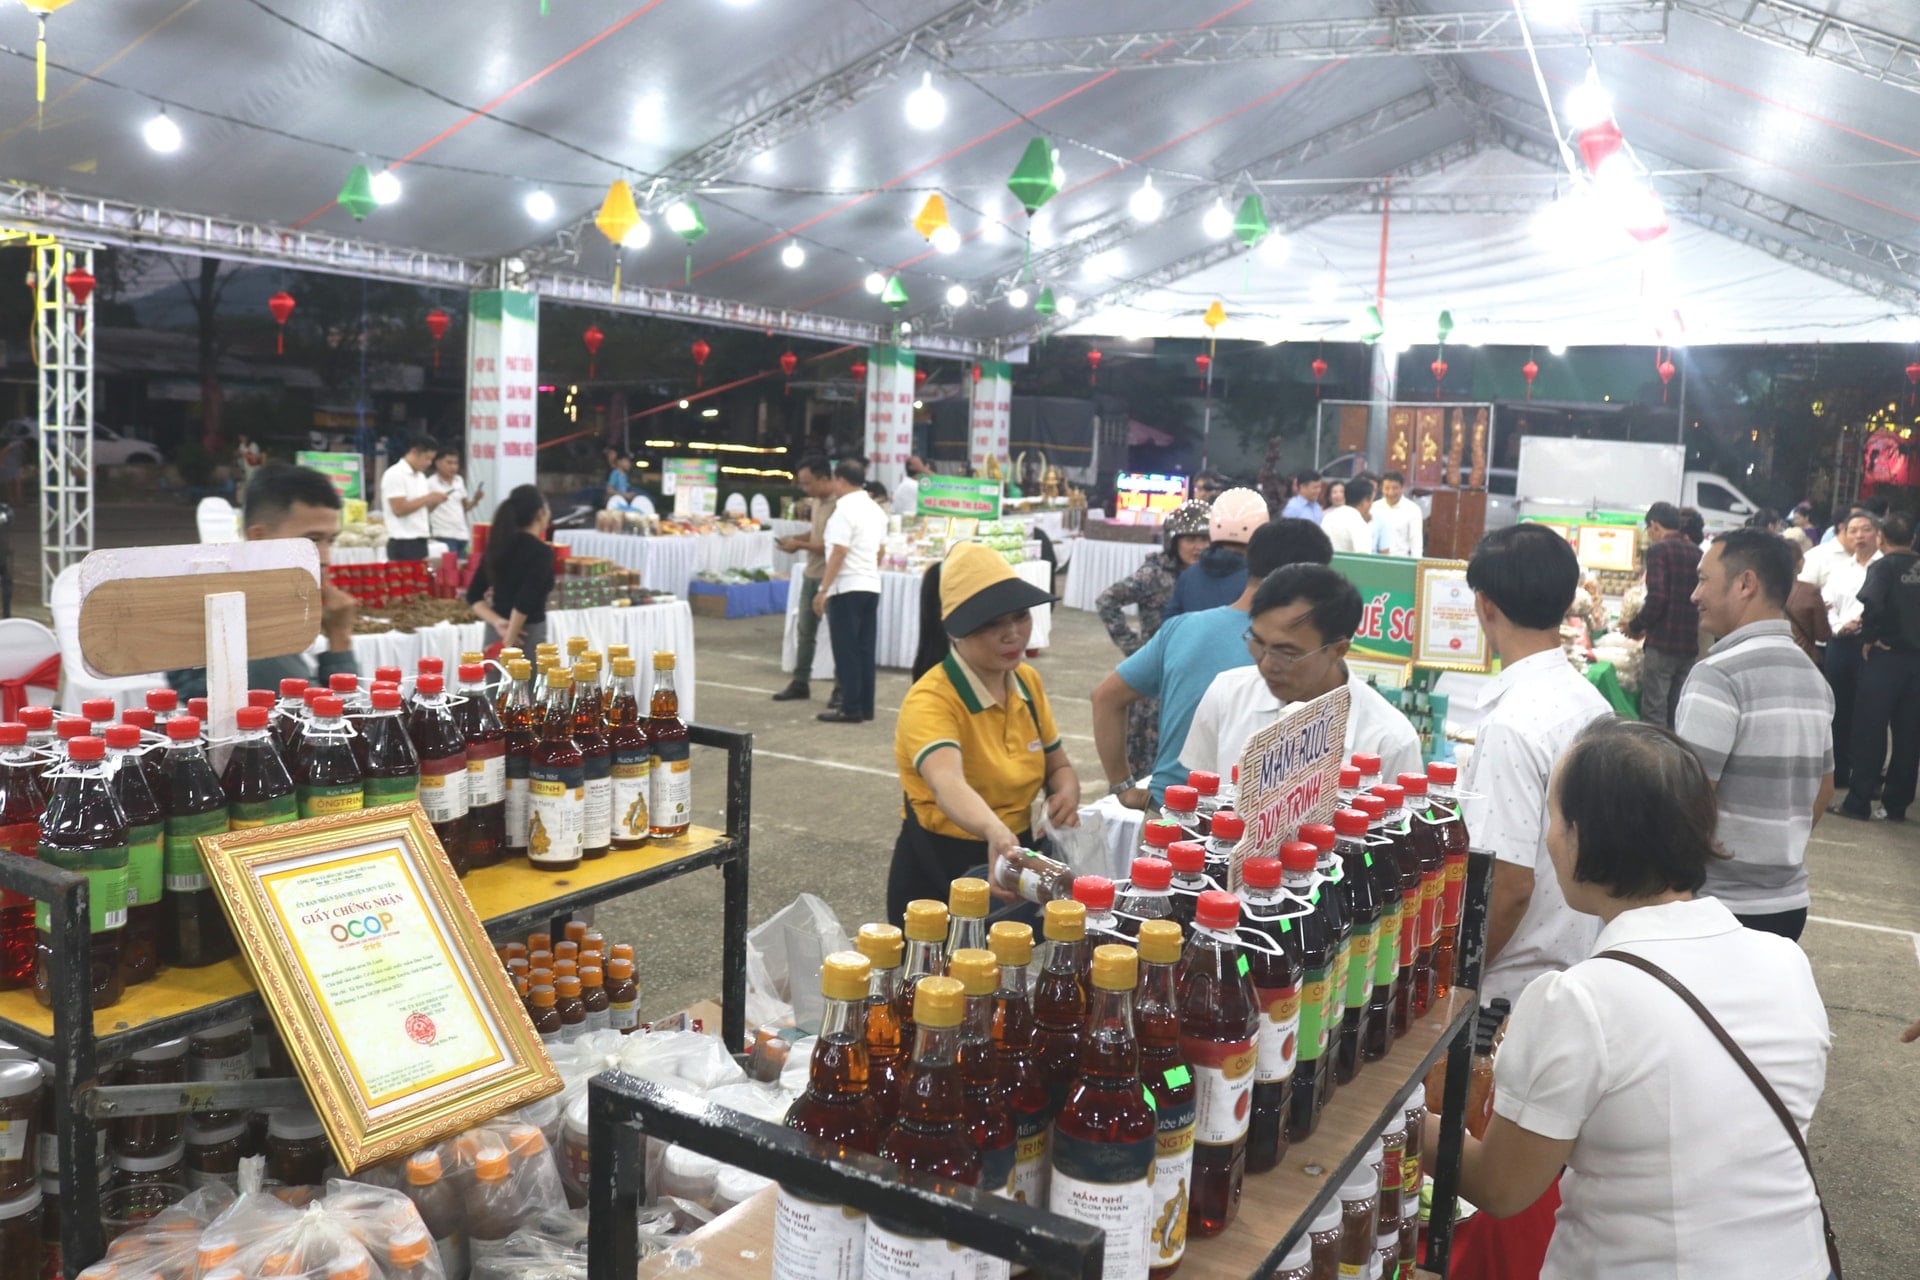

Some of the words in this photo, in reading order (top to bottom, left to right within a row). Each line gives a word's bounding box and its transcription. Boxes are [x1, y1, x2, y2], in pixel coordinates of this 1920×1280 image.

[1356, 593, 1390, 638] UẾ
[316, 797, 362, 809] ÔNGTRIN
[1256, 802, 1282, 849] DUY
[1286, 773, 1322, 824] TRINH
[301, 908, 331, 925] GIẤY
[333, 902, 372, 917] CHỨNG
[330, 912, 393, 942] OCOP
